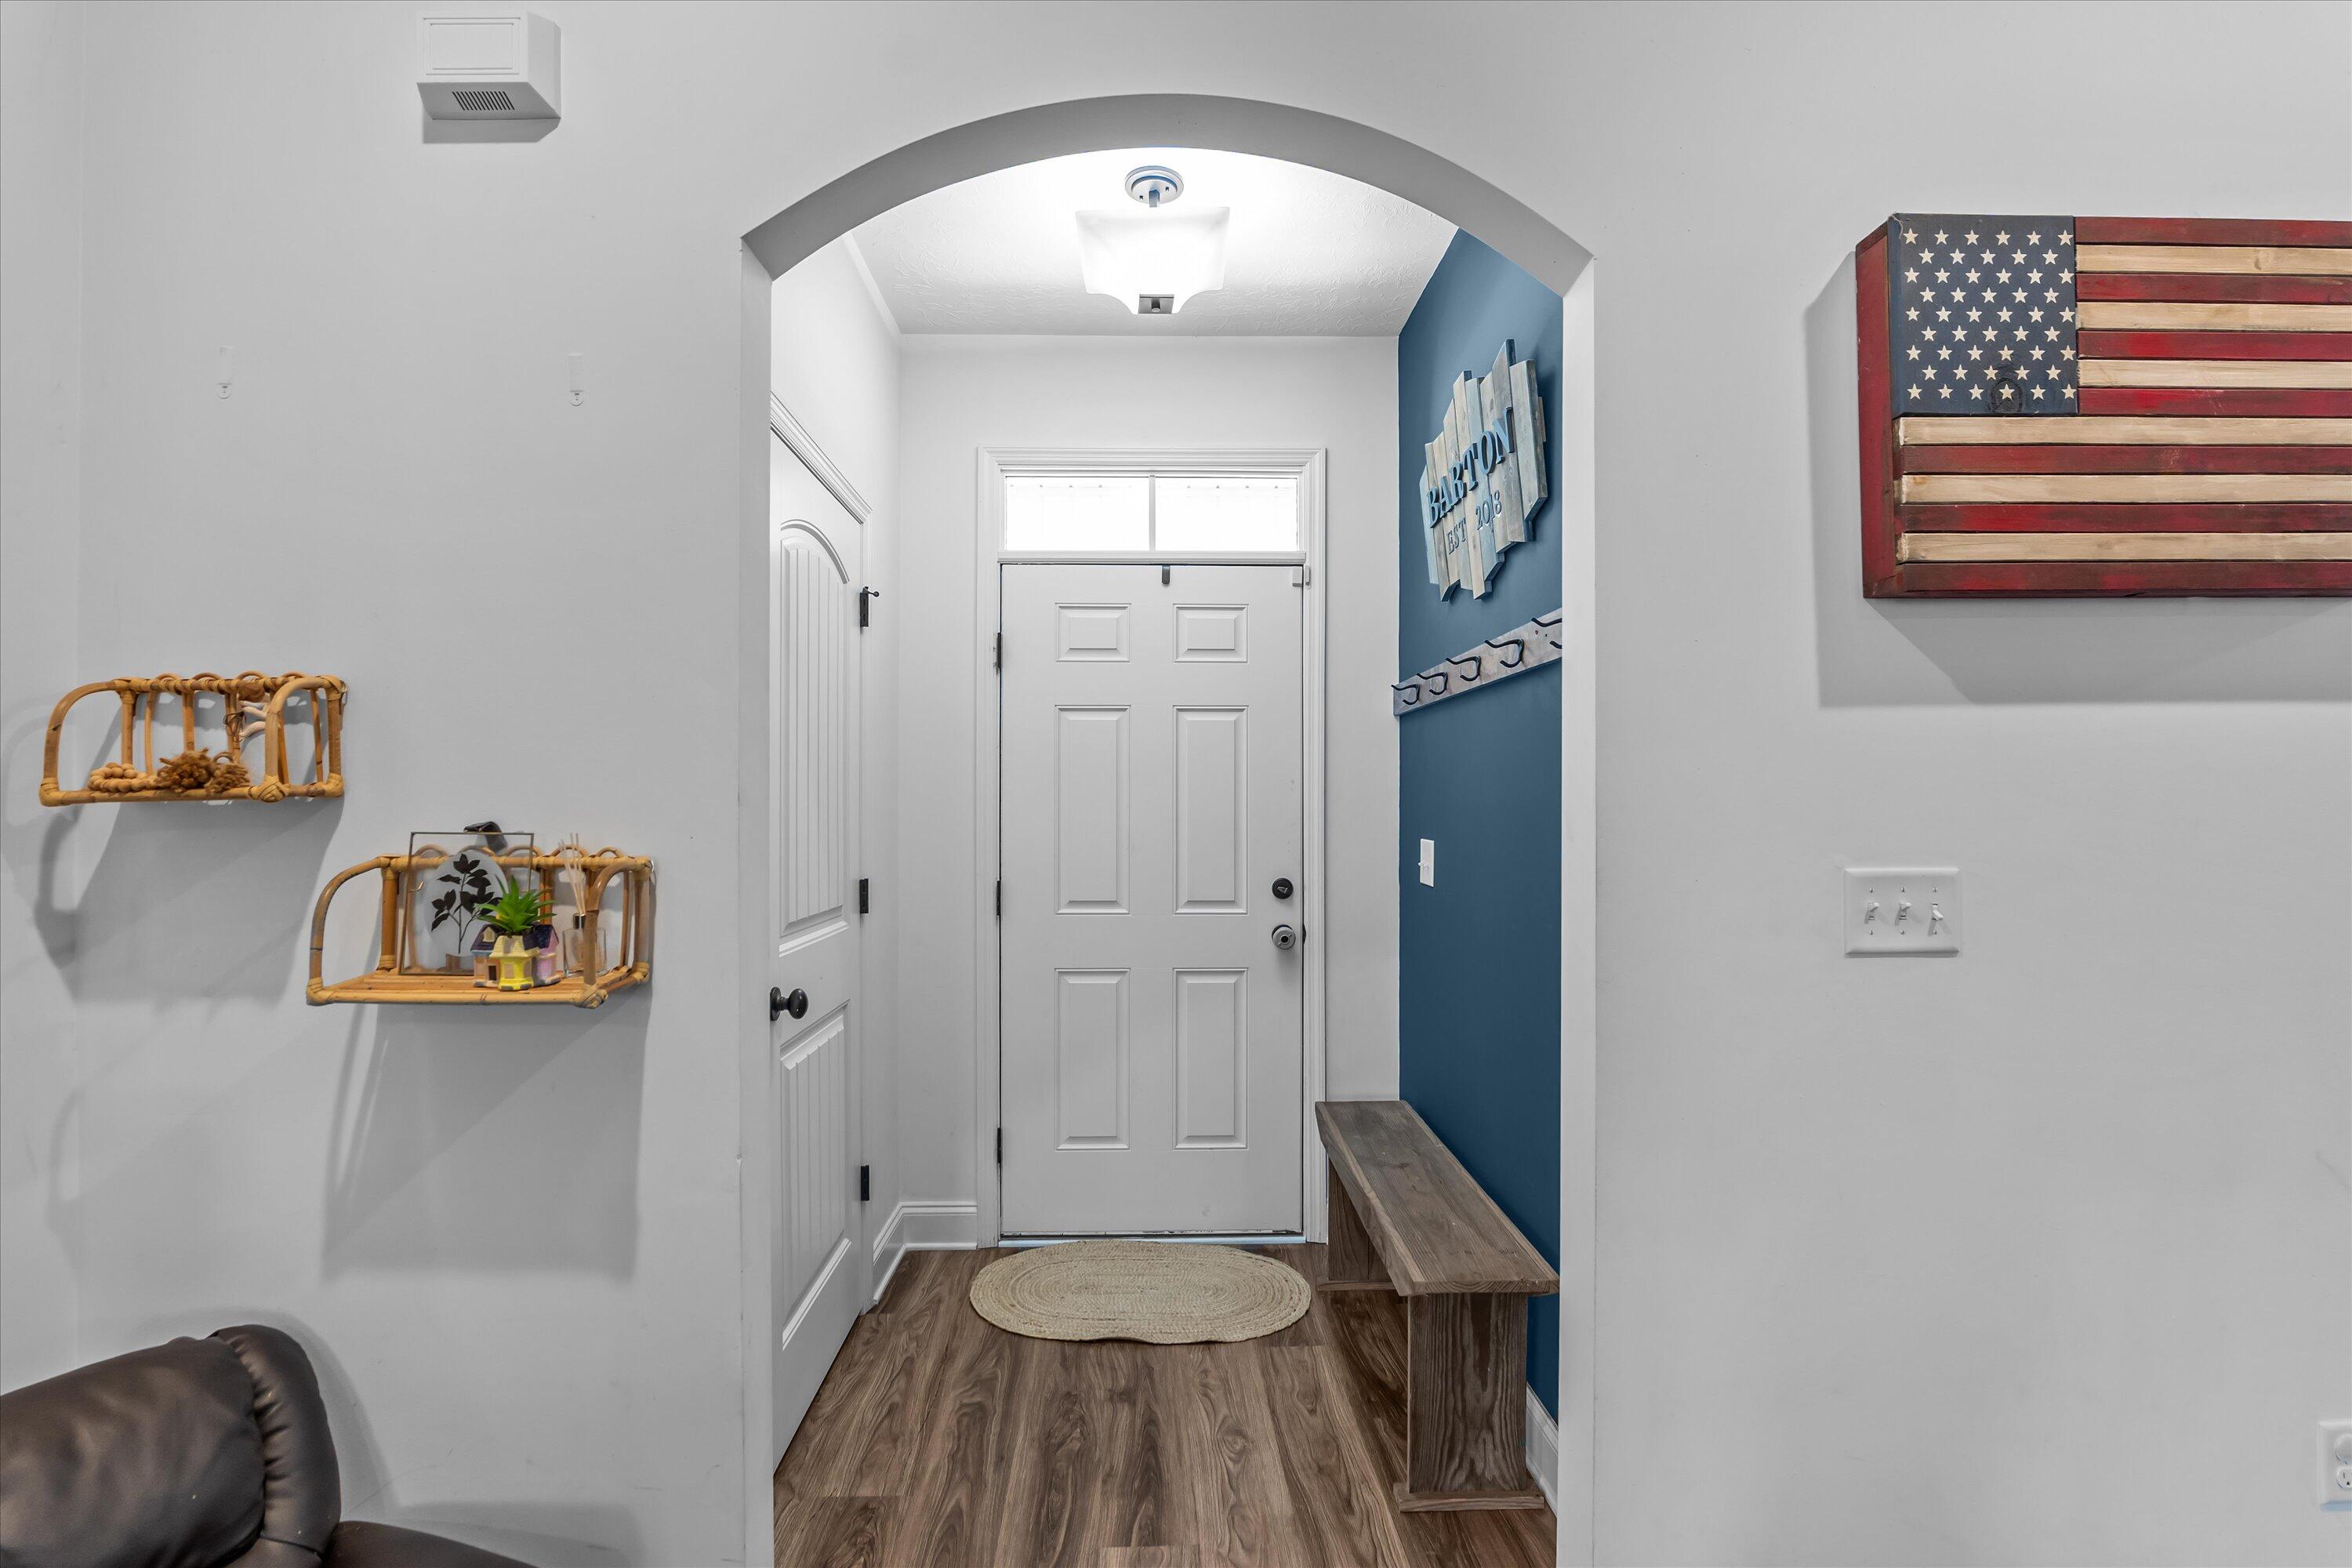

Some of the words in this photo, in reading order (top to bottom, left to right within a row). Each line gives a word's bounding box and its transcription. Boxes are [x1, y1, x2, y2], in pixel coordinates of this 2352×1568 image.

[1426, 406, 1515, 528] BARTON
[1446, 517, 1466, 554] EST
[1475, 489, 1502, 531] 2018
